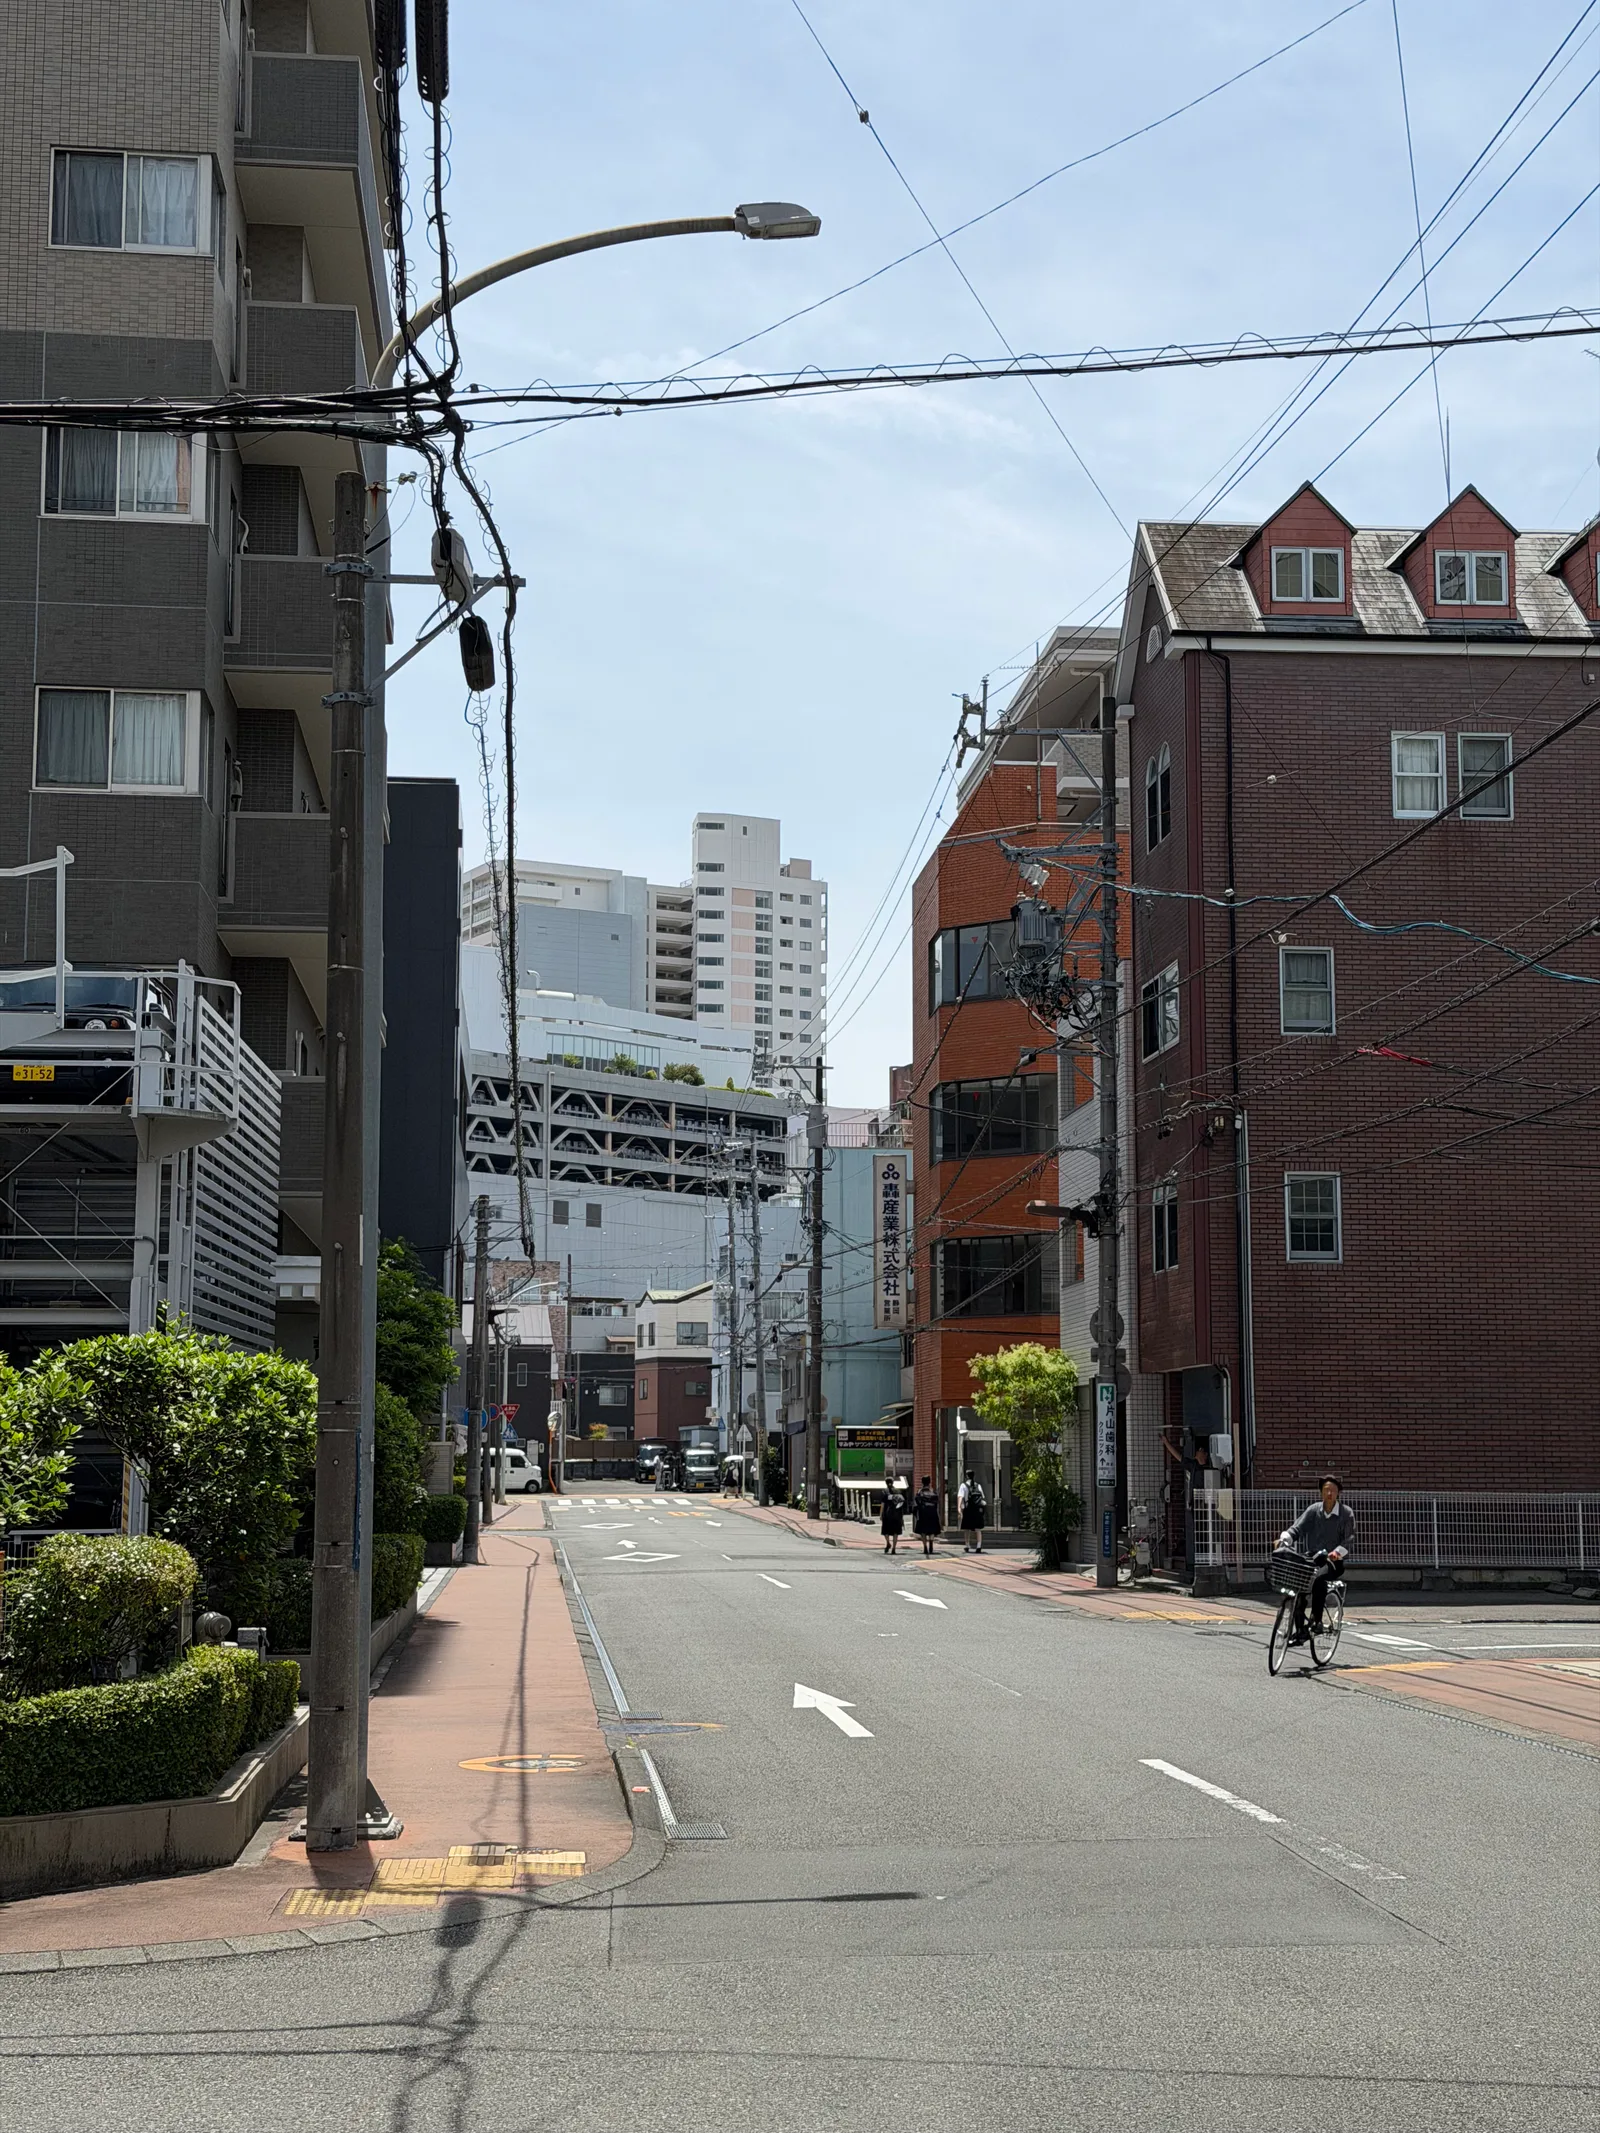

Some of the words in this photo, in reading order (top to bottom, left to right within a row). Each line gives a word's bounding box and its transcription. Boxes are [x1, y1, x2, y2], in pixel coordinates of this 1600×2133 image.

[22, 1069, 52, 1079] 31-52
[882, 1183, 900, 1296] 轟産業株式会社
[1105, 1404, 1115, 1456] 片山歯科
